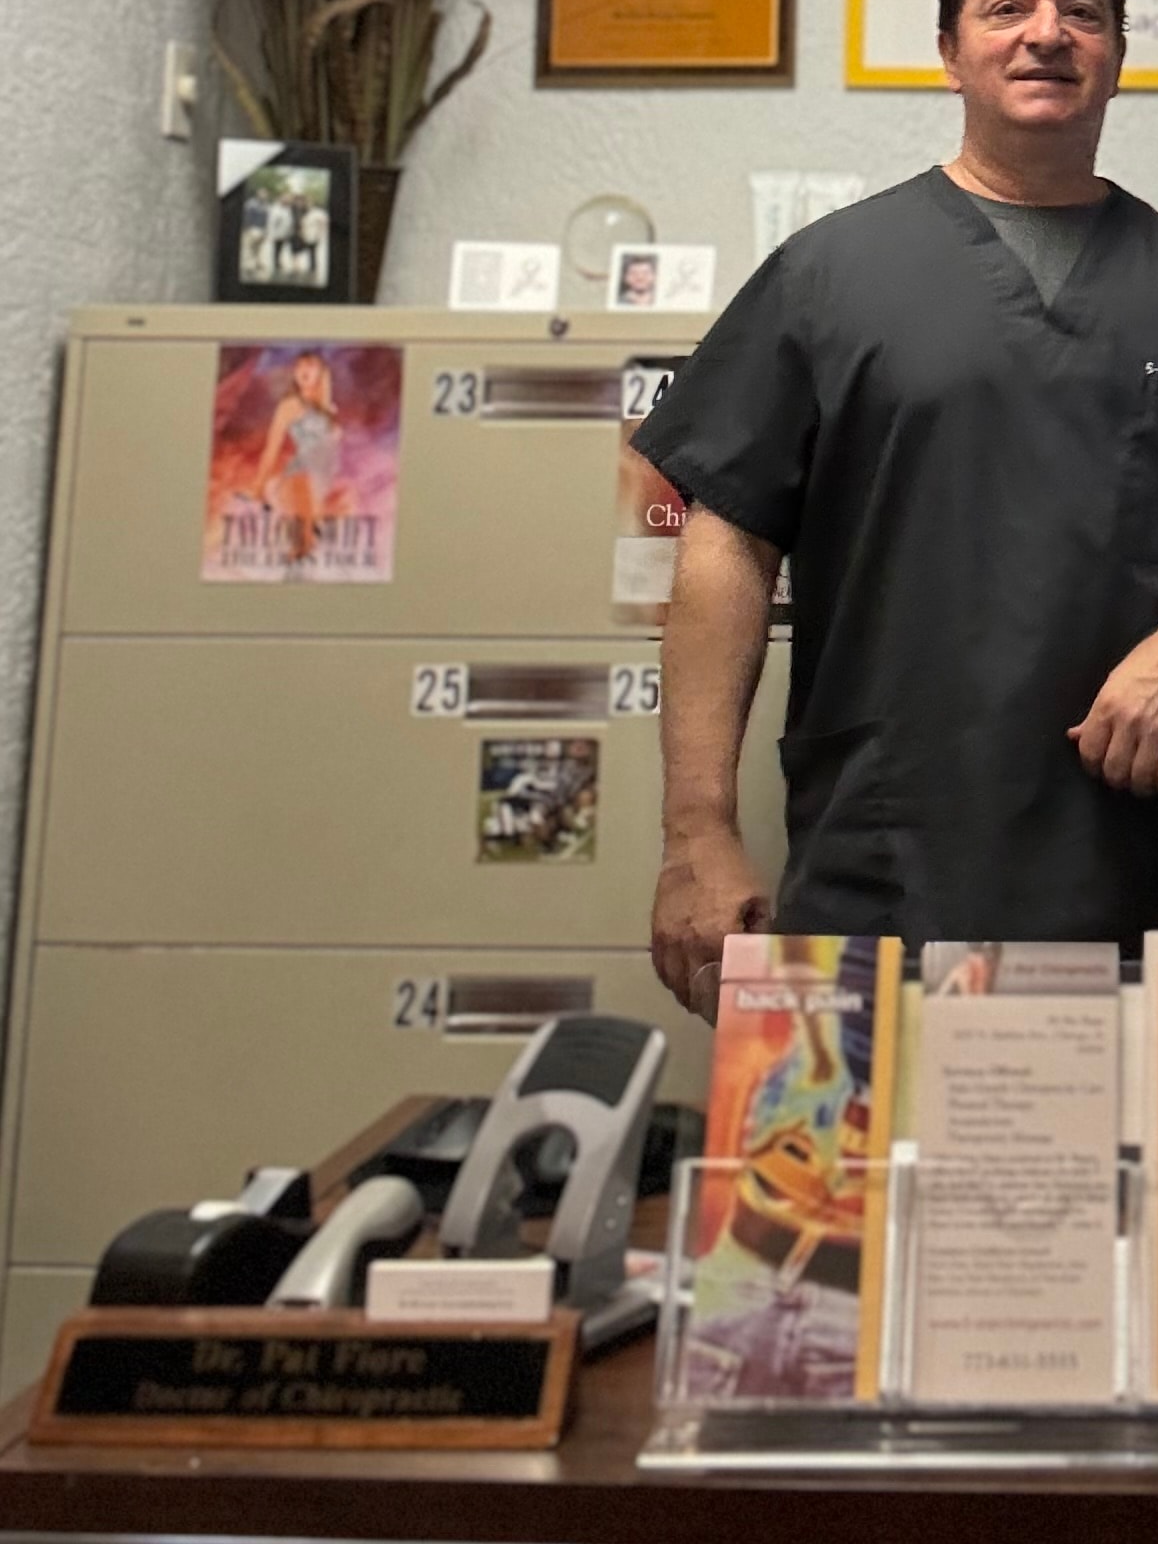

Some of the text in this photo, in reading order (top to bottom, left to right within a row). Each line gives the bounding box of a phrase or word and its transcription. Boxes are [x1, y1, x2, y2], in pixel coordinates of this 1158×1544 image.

[435, 372, 477, 414] 23
[416, 669, 461, 711] 25
[614, 669, 659, 711] 25
[395, 980, 441, 1027] 24
[737, 987, 862, 1013] back pain
